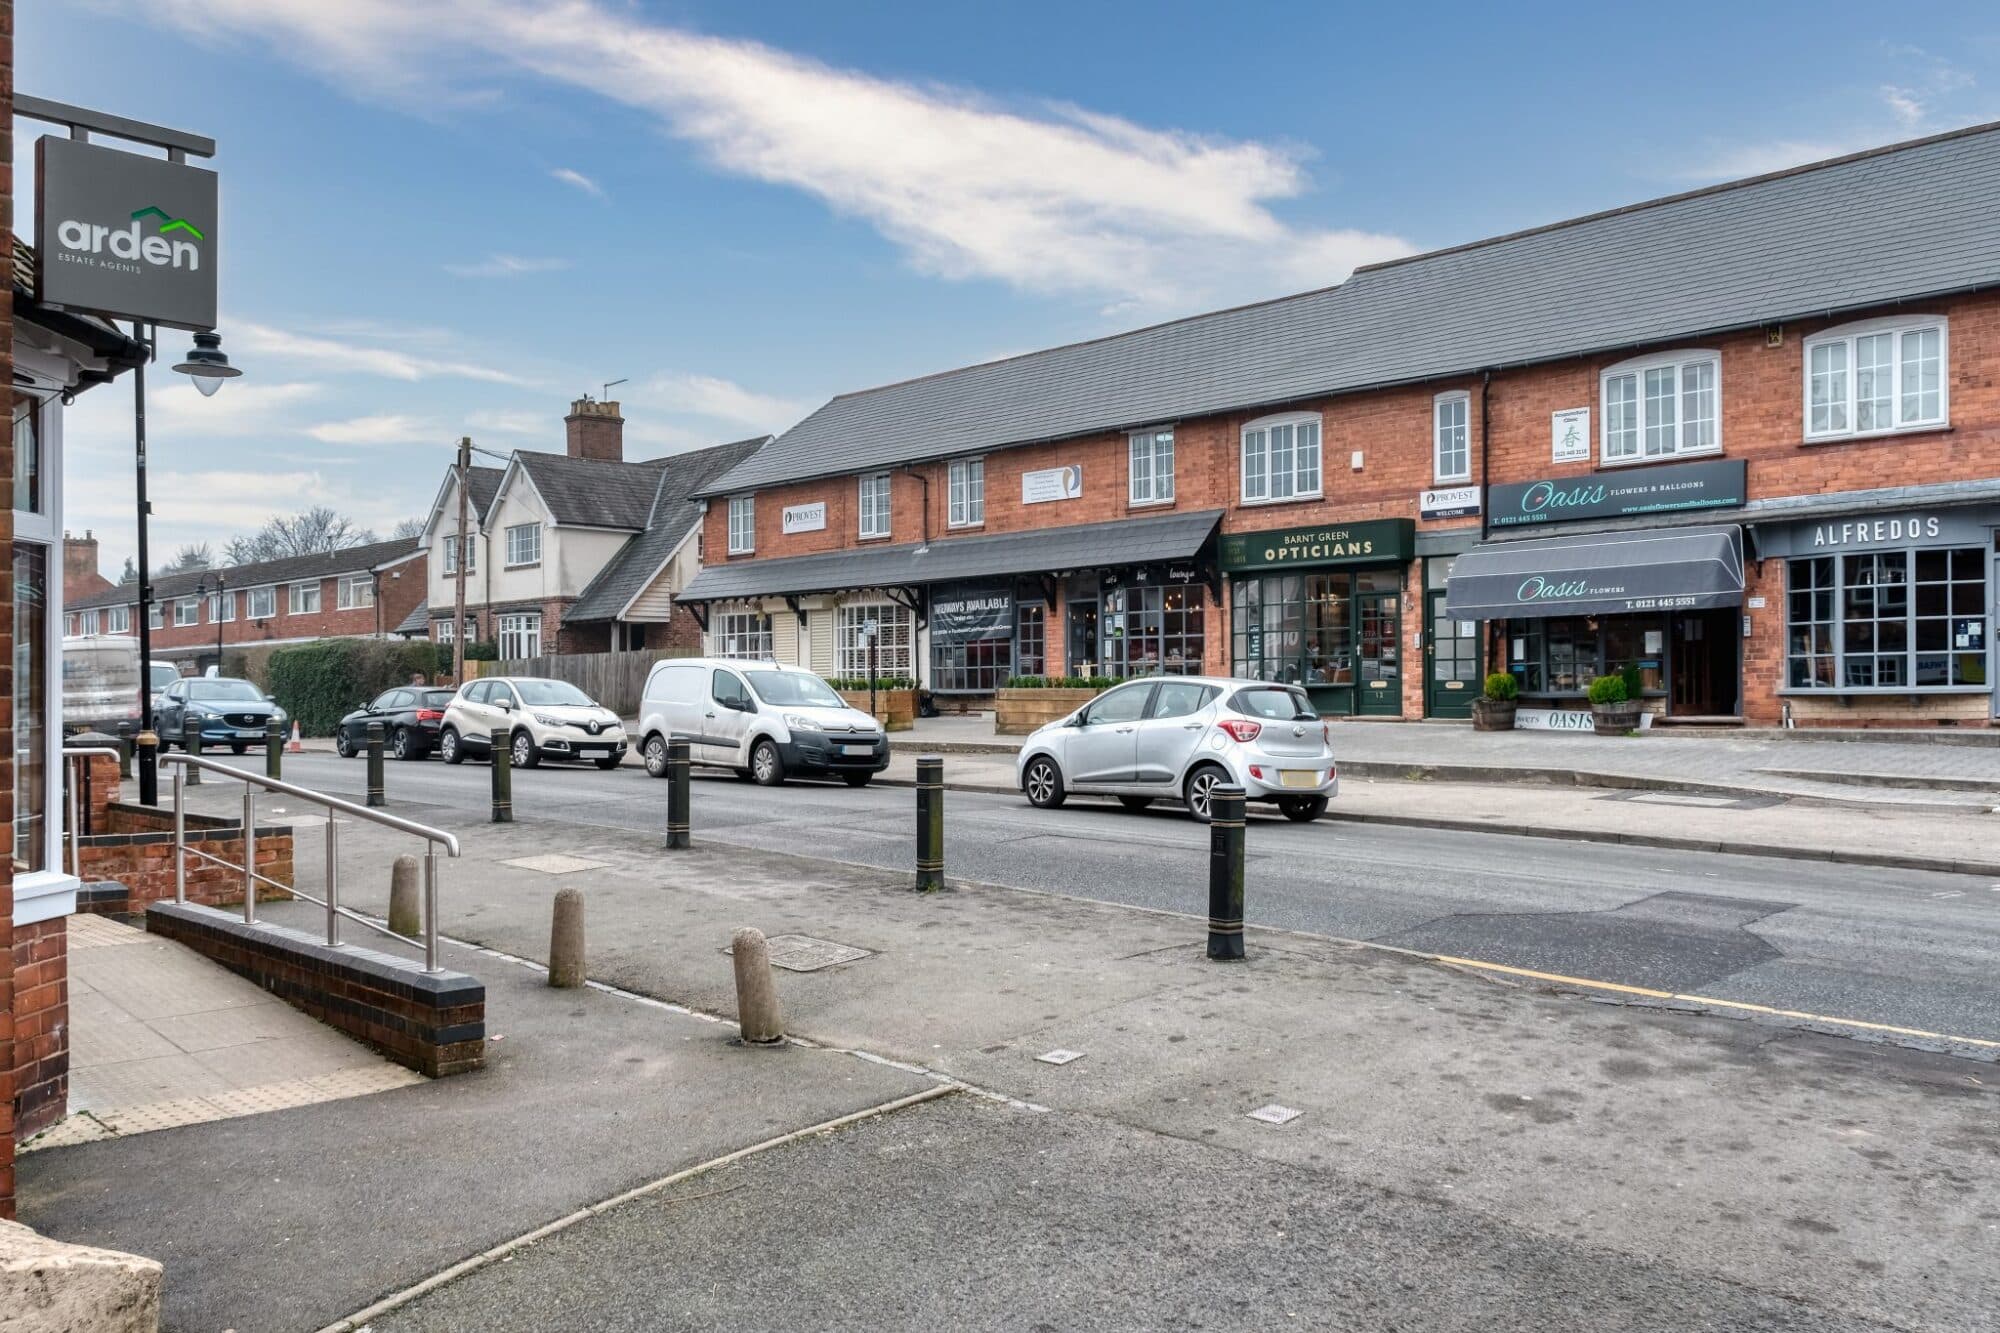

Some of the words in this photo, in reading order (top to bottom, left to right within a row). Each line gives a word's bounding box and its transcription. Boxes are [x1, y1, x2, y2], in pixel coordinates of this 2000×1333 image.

[57, 219, 199, 271] arden
[58, 252, 95, 266] ESTATE
[100, 259, 142, 274] AGENTS
[1436, 490, 1473, 502] PROVEST
[1522, 481, 1607, 512] Oasis
[1610, 486, 1648, 496] FLOWERS
[1660, 481, 1704, 491] BALLOONS
[792, 509, 822, 522] PROVEST
[1501, 516, 1517, 525] 0121
[1284, 533, 1315, 545] BARNT
[1318, 530, 1349, 542] GREEN
[1814, 517, 1939, 546] ALFREDOS
[1264, 541, 1373, 561] OPTICIANS
[1517, 576, 1588, 601] Oasis
[1590, 586, 1625, 594] FLOWERS
[966, 597, 1009, 612] AVAILABLE
[1625, 600, 1634, 609] T.
[1636, 599, 1656, 609] 0121
[1658, 598, 1674, 608] 445
[1675, 597, 1696, 607] 5551
[1549, 711, 1593, 729] OASIS
